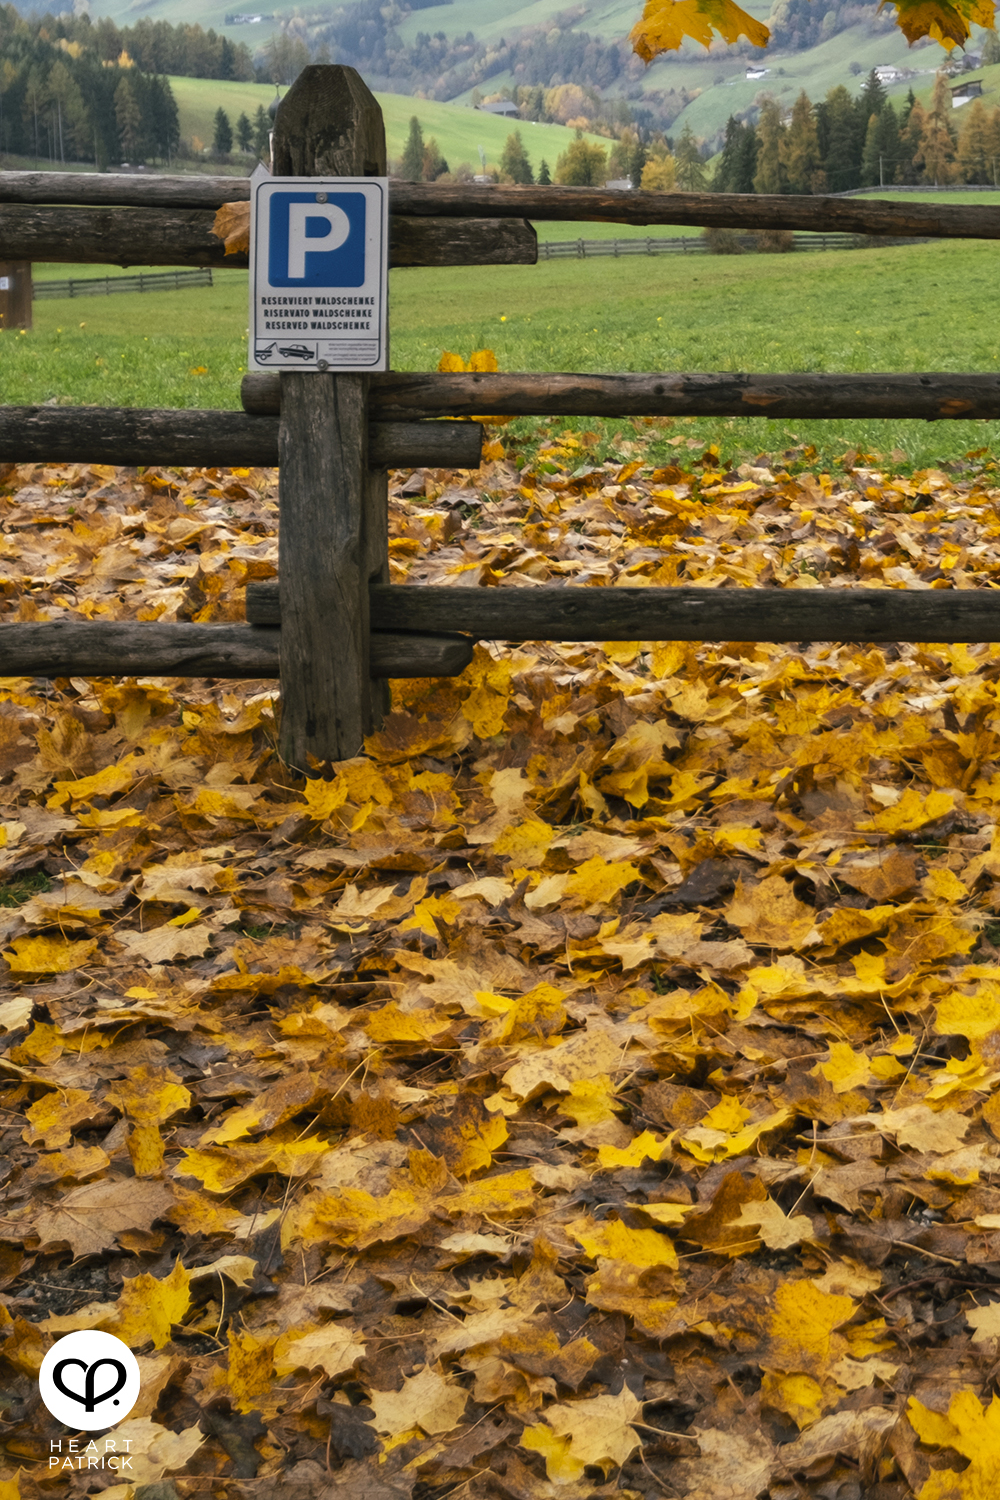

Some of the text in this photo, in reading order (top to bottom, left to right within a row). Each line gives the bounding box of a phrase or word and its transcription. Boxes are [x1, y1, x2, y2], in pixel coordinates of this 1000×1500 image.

[288, 202, 351, 279] P
[261, 296, 375, 305] RESERVIERT WALDSCHENKE
[263, 309, 373, 318] RISERVATO WALDSCHENKE
[265, 321, 371, 330] RESERVED WALDSCHENKE
